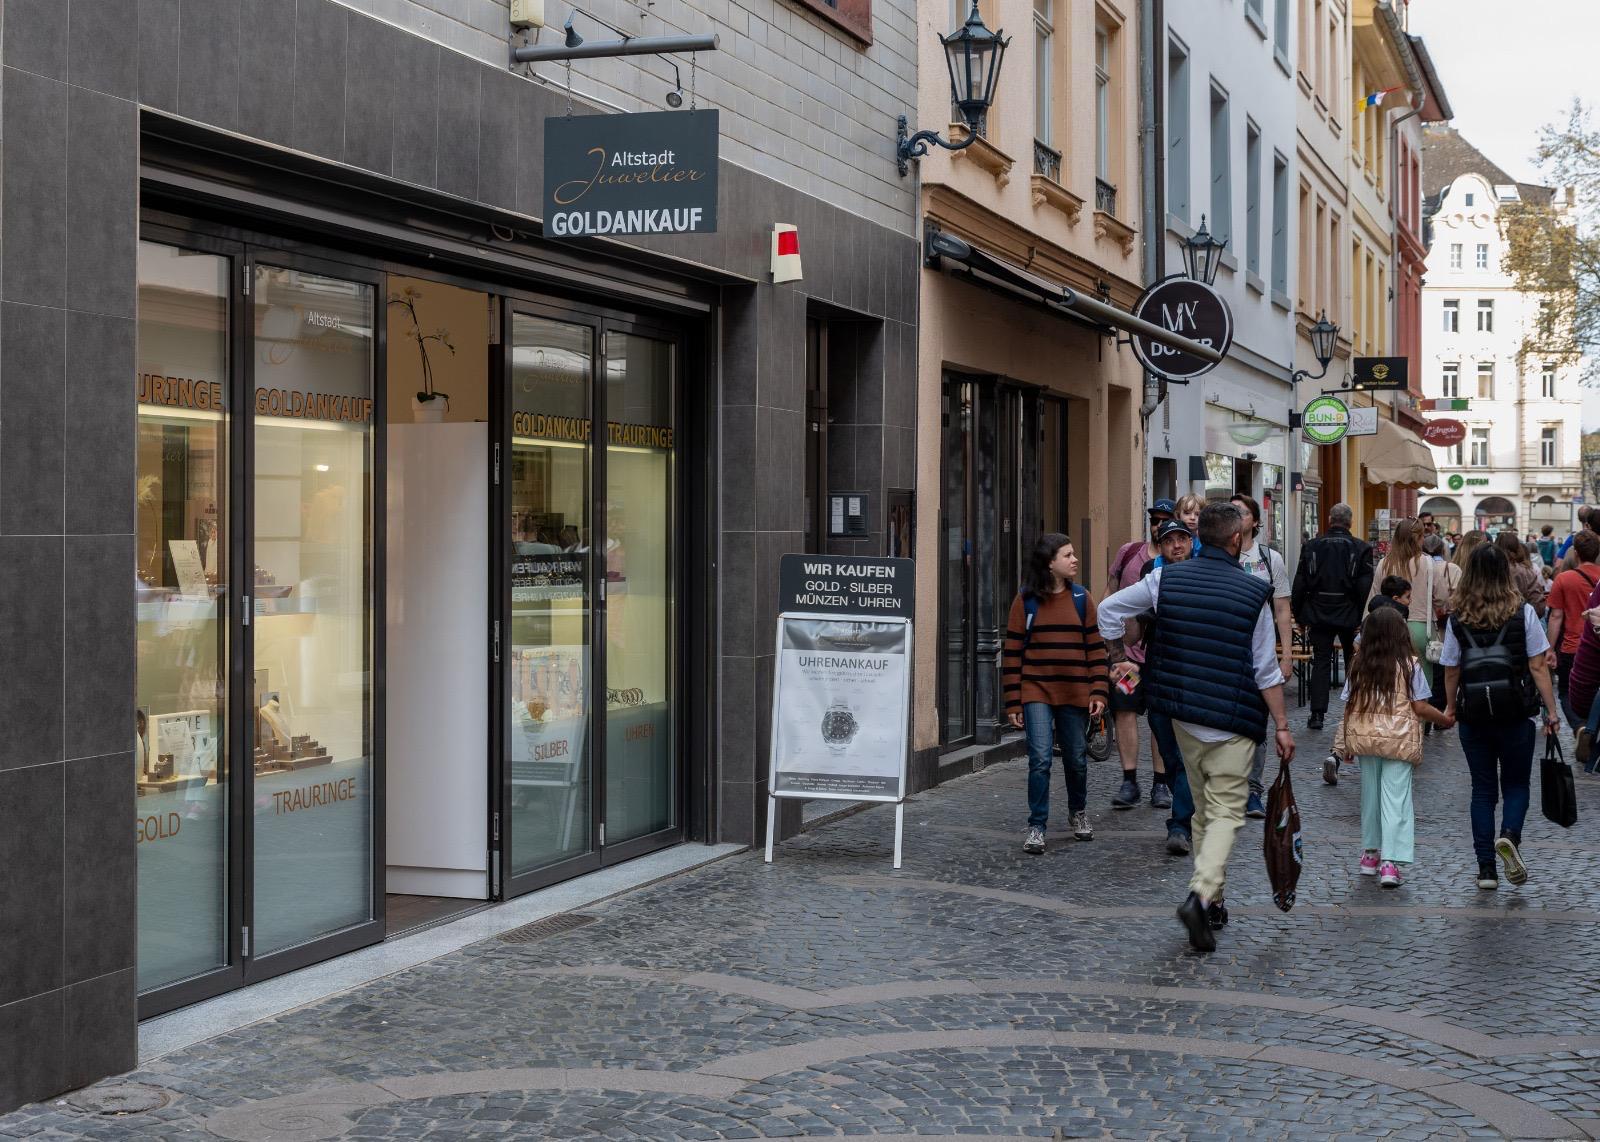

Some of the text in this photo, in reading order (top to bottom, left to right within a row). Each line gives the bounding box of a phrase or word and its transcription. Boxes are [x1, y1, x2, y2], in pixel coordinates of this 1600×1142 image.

[611, 150, 676, 167] Altstadt
[553, 147, 707, 205] Juwelier
[551, 207, 703, 236] GOLDANKAUF
[307, 311, 342, 329] Altstadt
[255, 387, 374, 423] GOLDANKAUF
[513, 411, 592, 441] GOLDANKAUF
[607, 421, 673, 448] TRAURINGE
[803, 562, 896, 578] WIR KAUFEN
[805, 580, 893, 594] GOLD SILBER
[795, 593, 901, 608] MÜNZEN UHREN
[798, 656, 889, 670] UHRENANKAUF
[624, 721, 657, 743] UHREN
[534, 739, 569, 761] SILBER
[272, 777, 357, 816] TRAURINGE
[137, 812, 181, 844] GOLD
